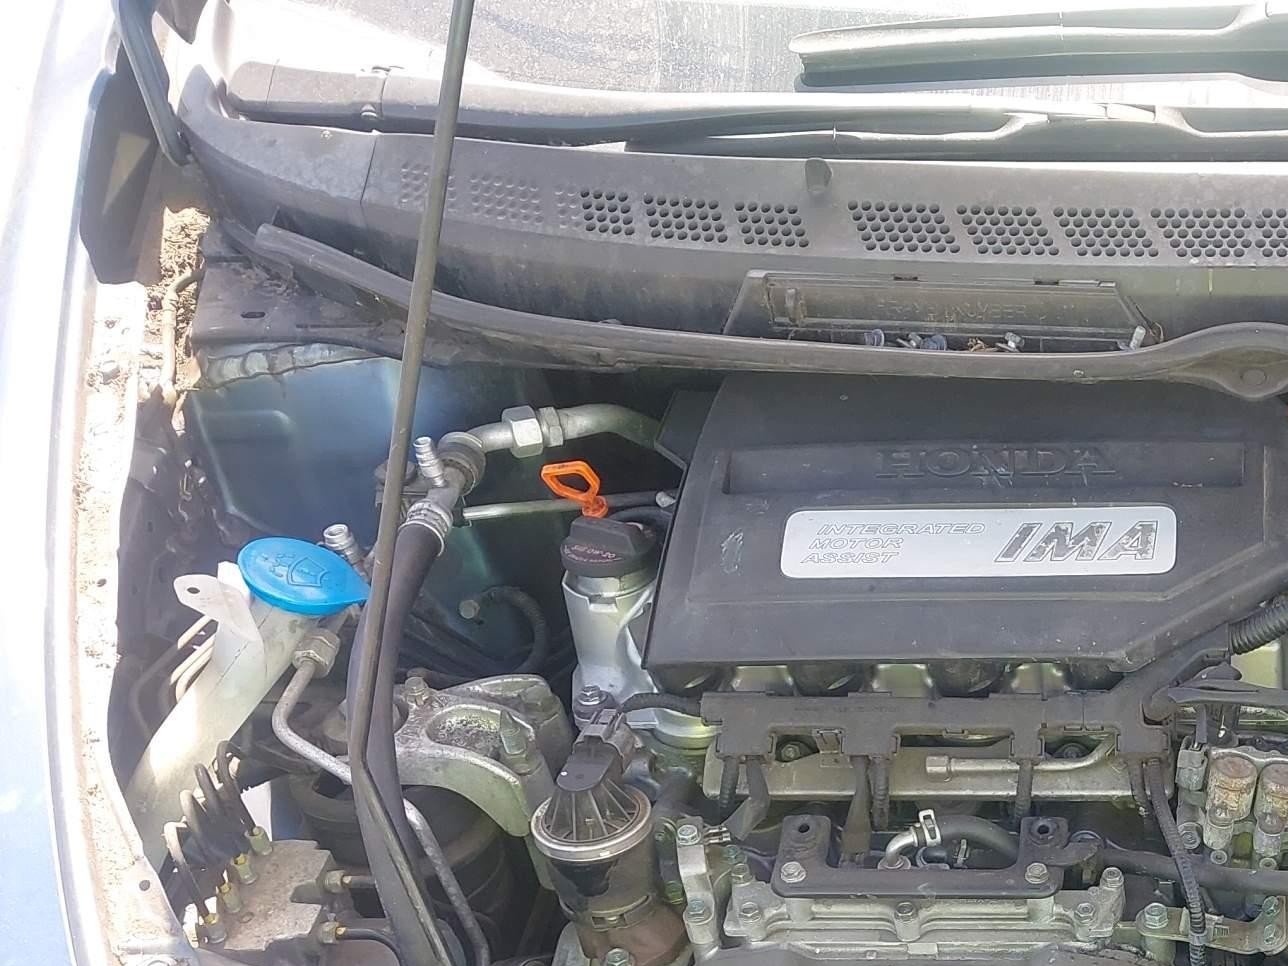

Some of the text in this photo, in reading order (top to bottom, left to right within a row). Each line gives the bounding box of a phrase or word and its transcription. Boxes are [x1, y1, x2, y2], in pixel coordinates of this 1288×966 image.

[875, 450, 1117, 478] HONDA
[817, 523, 985, 535] INTEGRATED
[809, 538, 904, 549] MOTOR
[994, 520, 1158, 562] IMA
[800, 552, 899, 563] ASSIST
